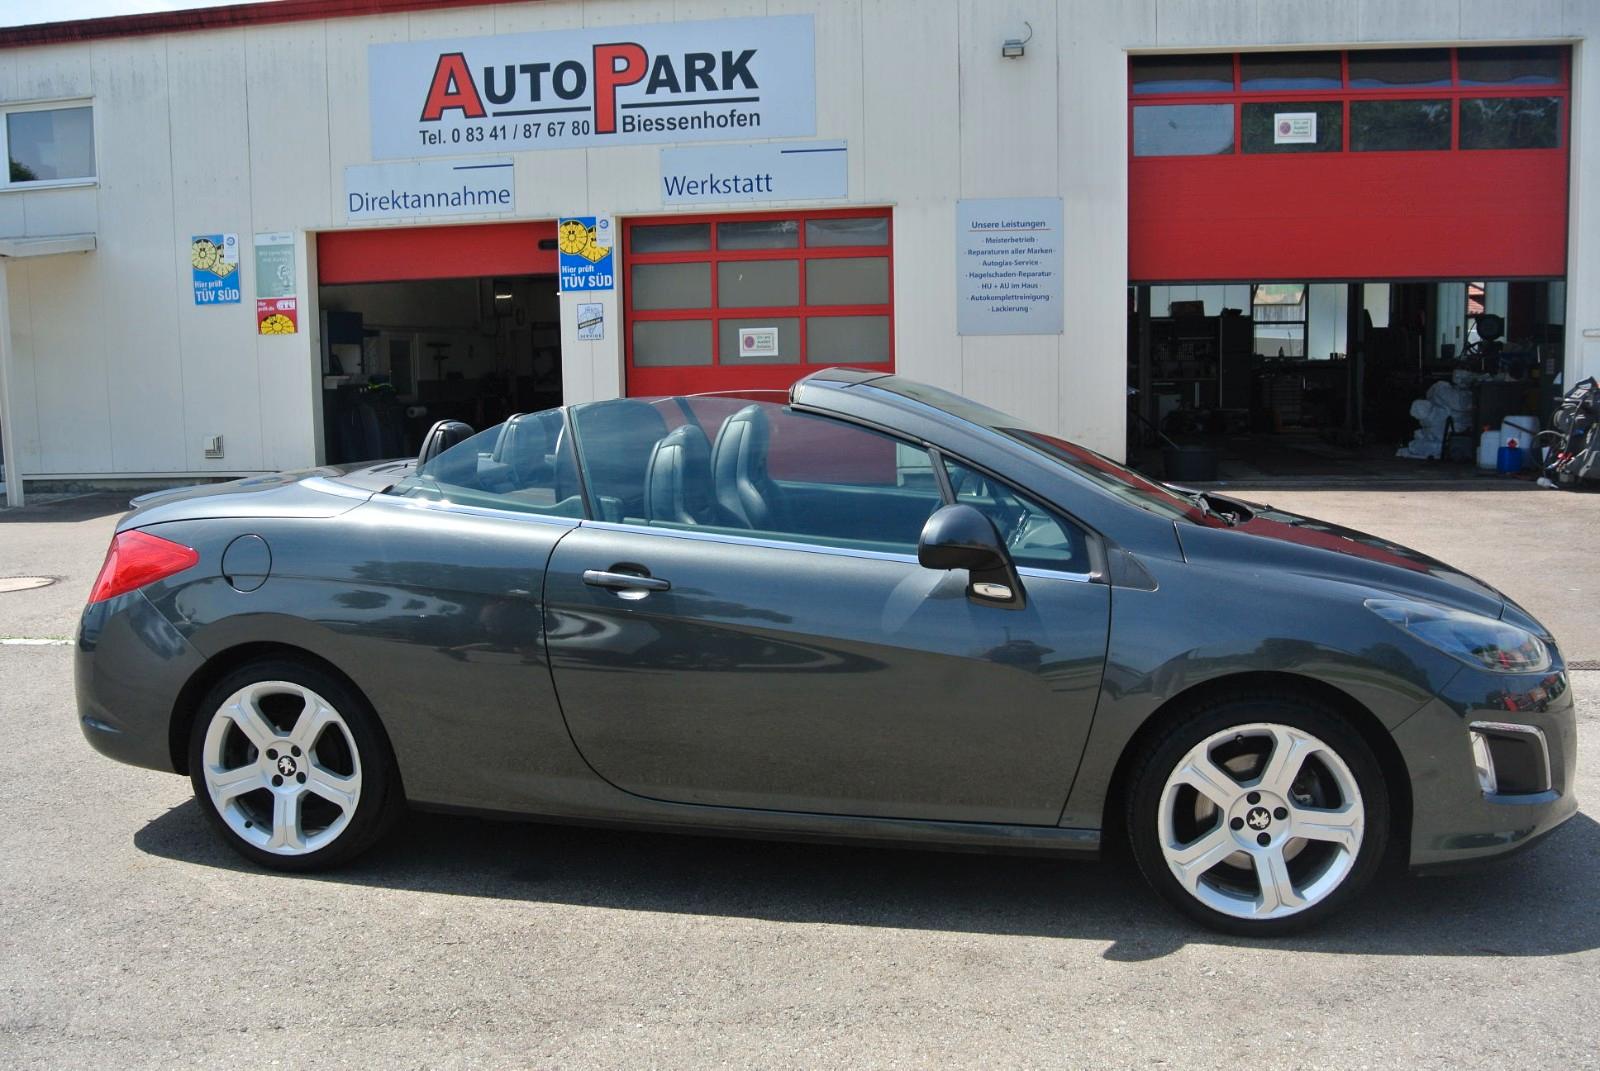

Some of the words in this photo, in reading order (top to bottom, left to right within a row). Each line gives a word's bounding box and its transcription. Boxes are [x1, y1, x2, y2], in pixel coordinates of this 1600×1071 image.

[622, 109, 761, 133] Biessenhofen
[419, 129, 447, 145] Tel.
[451, 128, 461, 143] 0
[465, 126, 484, 142] 83
[489, 124, 507, 141] 41
[512, 124, 518, 140] /
[523, 122, 541, 139] 87
[547, 121, 566, 138] 67
[571, 120, 590, 136] 80
[663, 173, 773, 196] Werkstatt
[349, 186, 511, 213] Direktannahme
[971, 221, 1000, 229] Unsere
[1001, 220, 1046, 229] Leistungen
[985, 236, 1035, 244] Meisterbetrieb
[967, 248, 1009, 256] Reparaturen
[562, 265, 577, 273] Hier
[577, 264, 594, 274] prüft
[562, 274, 586, 288] TÜV
[588, 273, 612, 287] SÜD
[195, 288, 216, 302] TÜV
[217, 287, 240, 301] SÜD
[970, 293, 1049, 301] Autokomplettreinigung
[991, 305, 1029, 313] Lackierung
